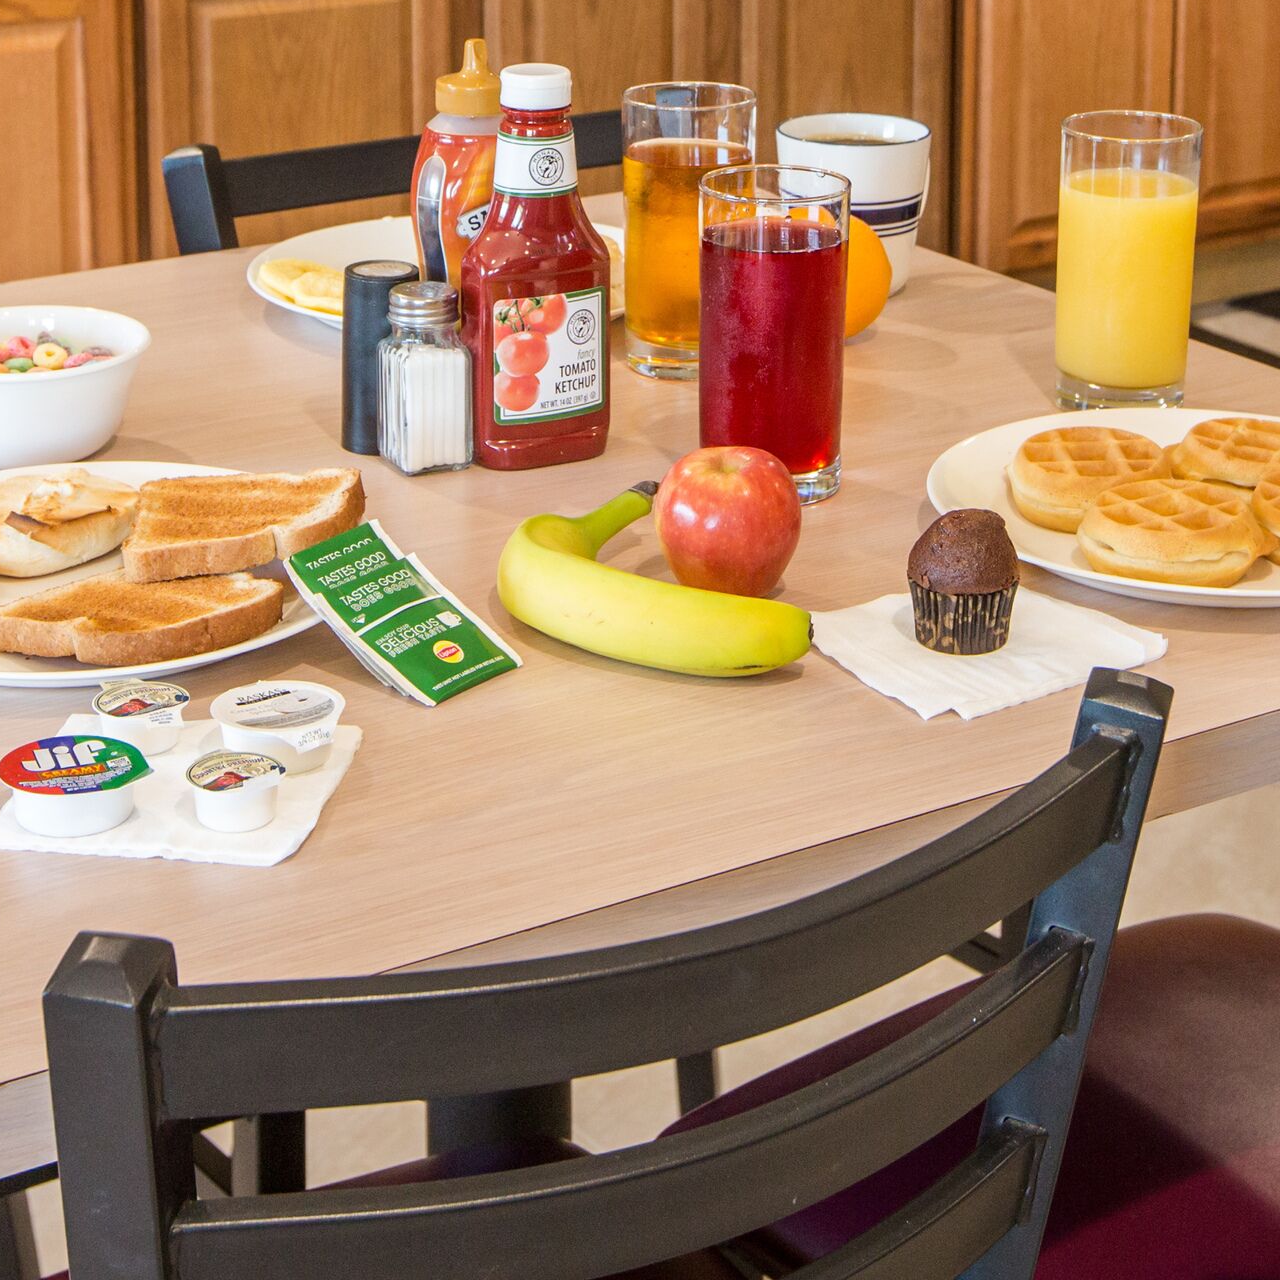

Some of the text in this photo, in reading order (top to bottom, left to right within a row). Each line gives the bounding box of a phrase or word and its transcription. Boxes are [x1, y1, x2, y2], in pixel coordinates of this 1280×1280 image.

[532, 149, 562, 163] MONARCH
[577, 348, 596, 361] fancy
[559, 358, 596, 378] TOMATO
[555, 374, 596, 395] KETCHUP
[540, 400, 551, 409] NET
[317, 551, 387, 587] TASTES GOOD
[339, 569, 412, 607] TASTES GOOD
[350, 591, 384, 612] DOES
[375, 624, 411, 646] ENJOY OUR
[380, 618, 440, 653] DELICIOUS
[438, 647, 459, 659] Lipton
[21, 740, 107, 771] Jif
[39, 763, 104, 779] CREAMY
[192, 764, 226, 780] COUNTRY
